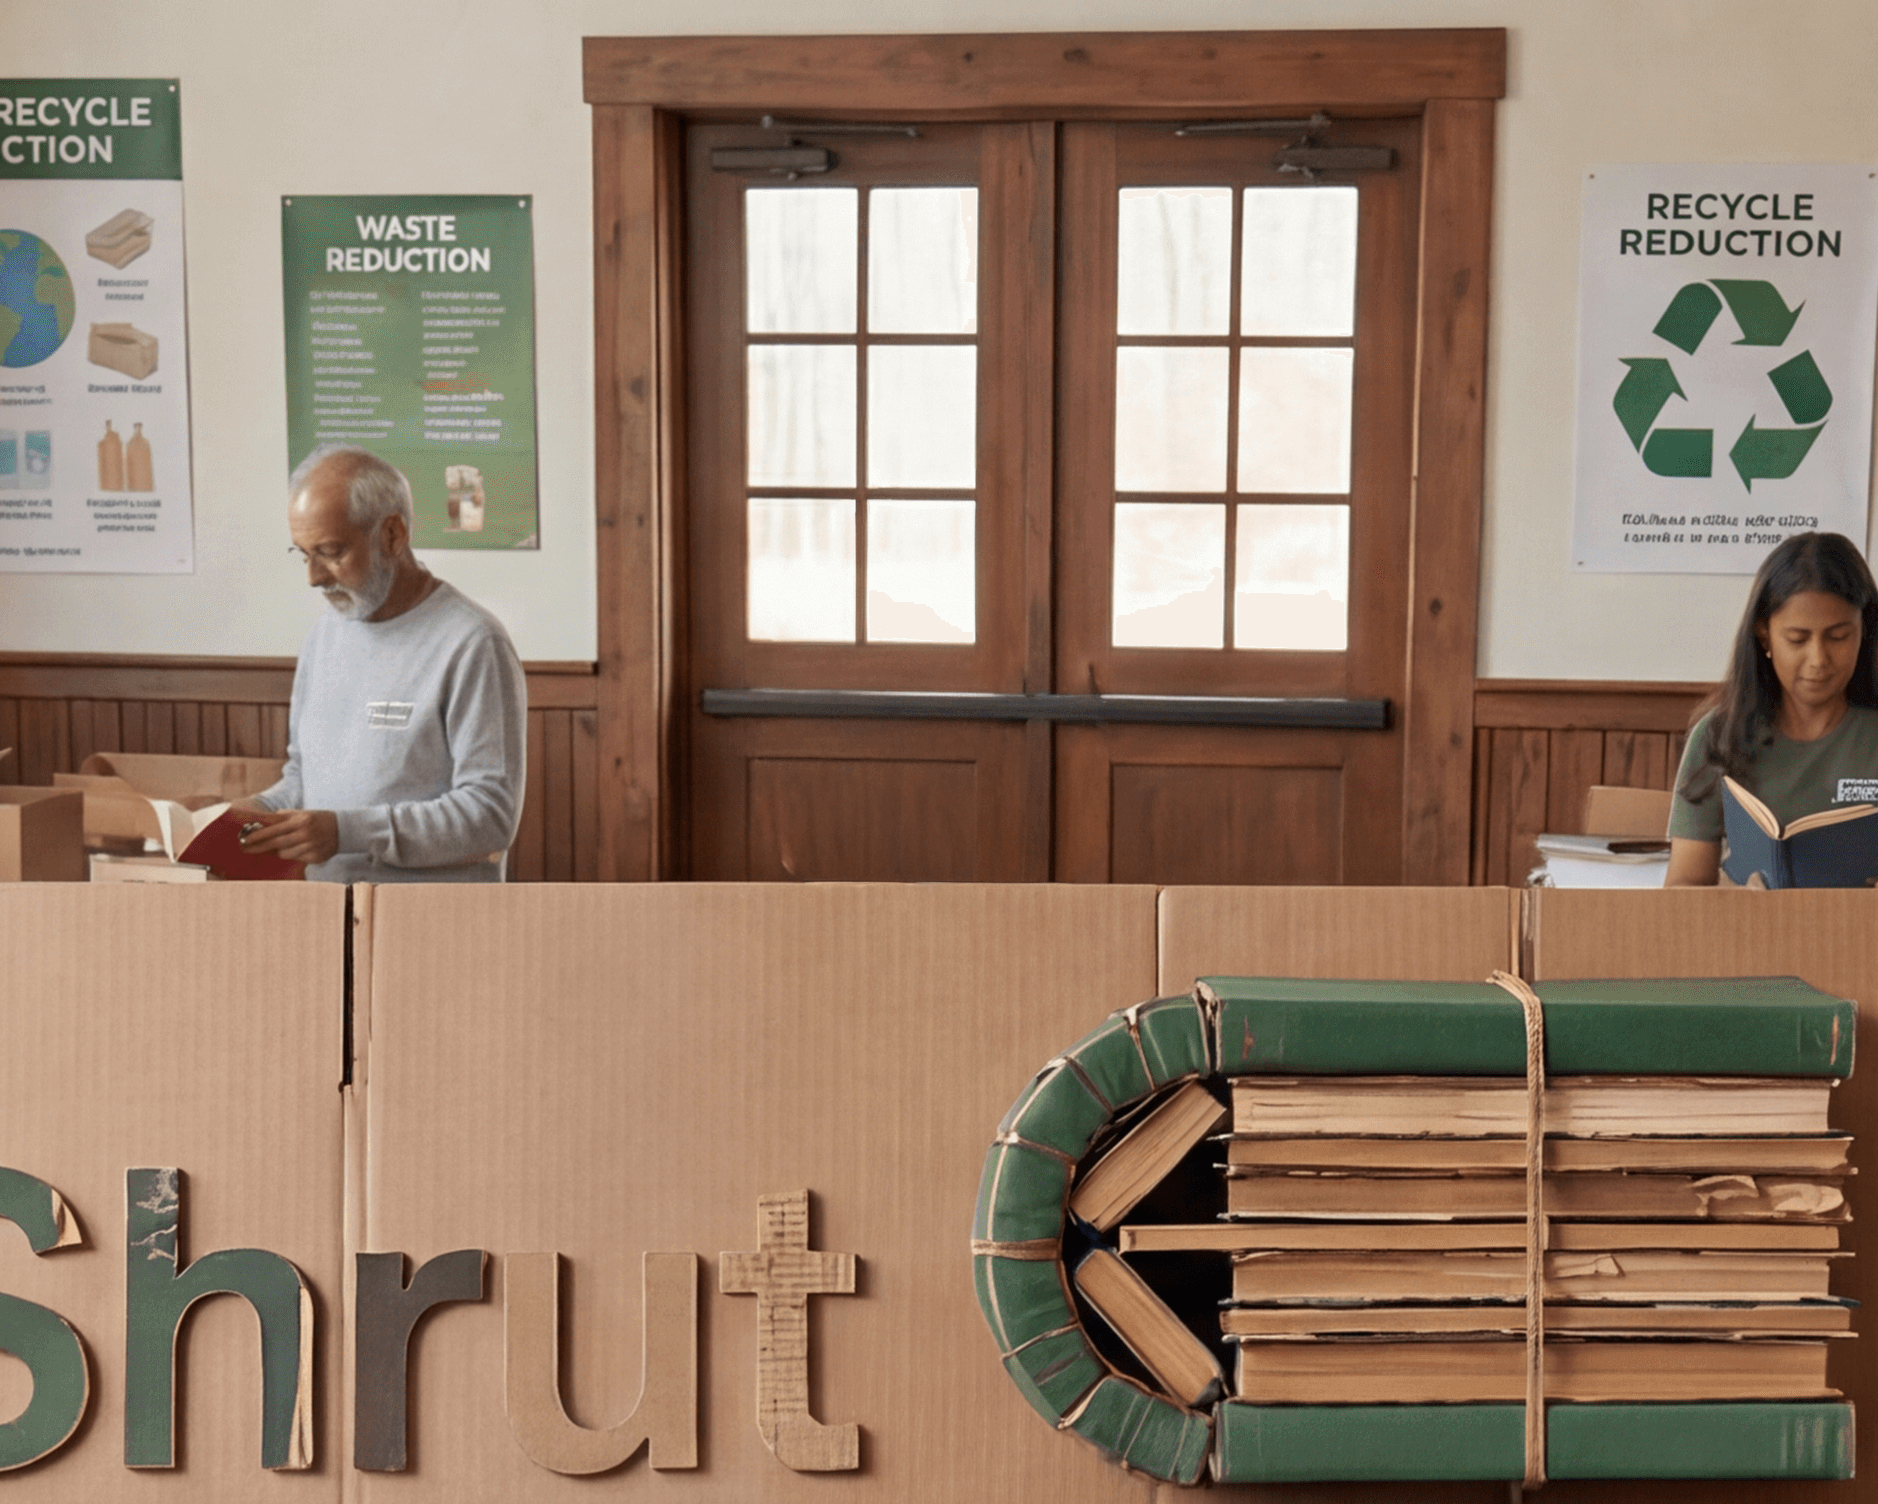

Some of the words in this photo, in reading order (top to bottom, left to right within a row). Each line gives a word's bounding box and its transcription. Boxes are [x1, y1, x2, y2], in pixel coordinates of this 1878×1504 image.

[1647, 193, 1815, 221] RECYCLE
[355, 215, 457, 241] WASTE
[1620, 229, 1841, 258] REDUCTION
[325, 247, 493, 273] REDUCTION
